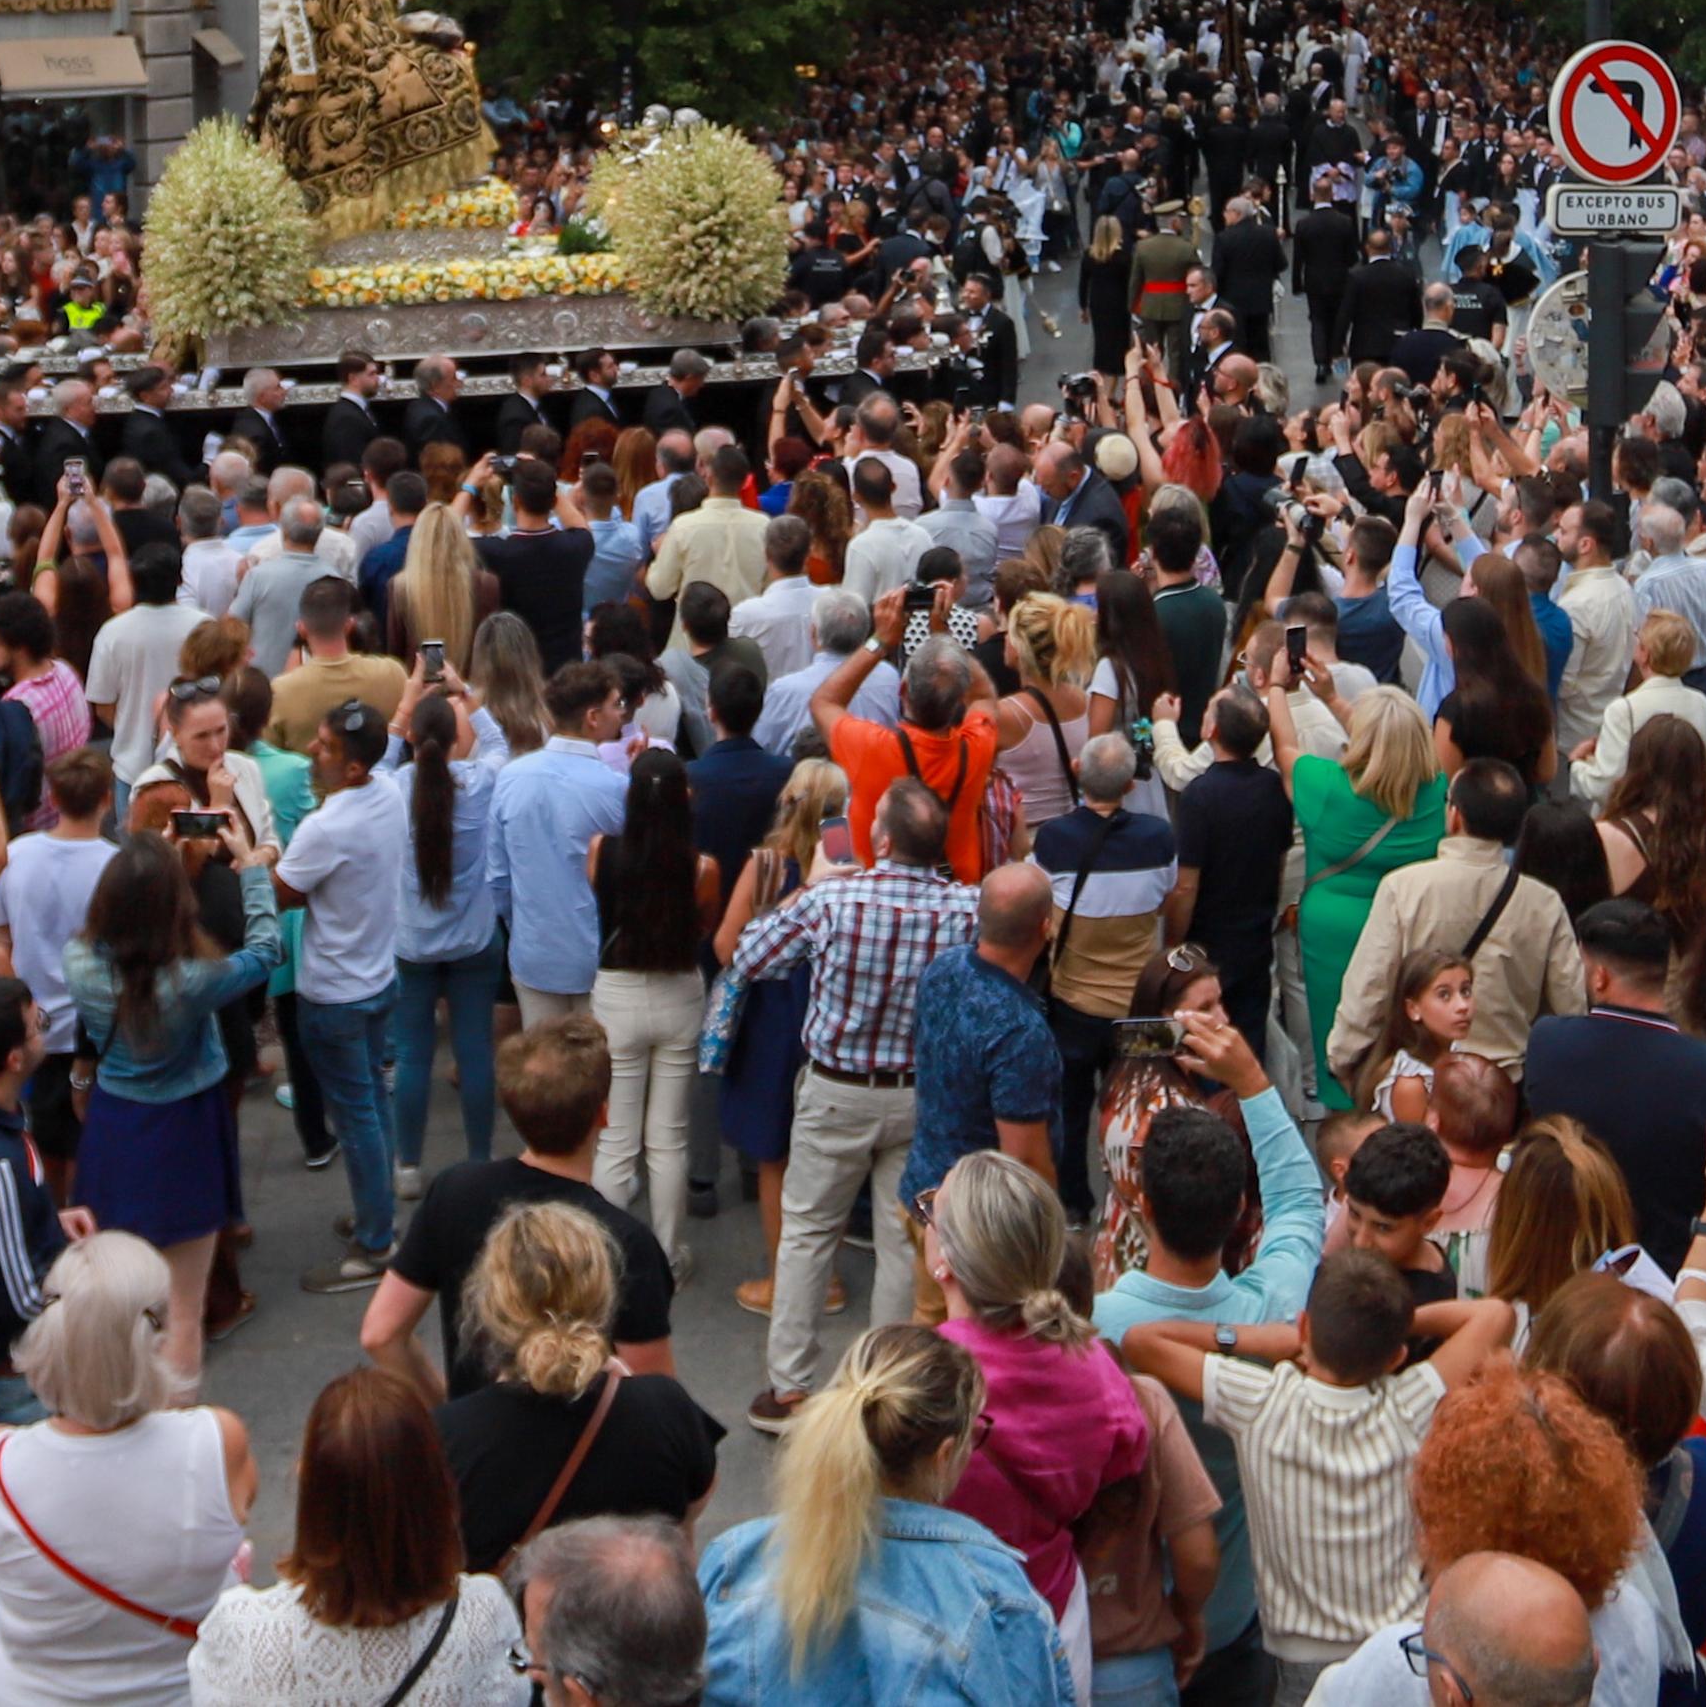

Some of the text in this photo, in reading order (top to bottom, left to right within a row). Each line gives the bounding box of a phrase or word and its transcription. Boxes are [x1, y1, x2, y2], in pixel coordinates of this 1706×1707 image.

[1566, 196, 1666, 209] EXCEPTO BUS
[1586, 213, 1649, 226] URBANO
